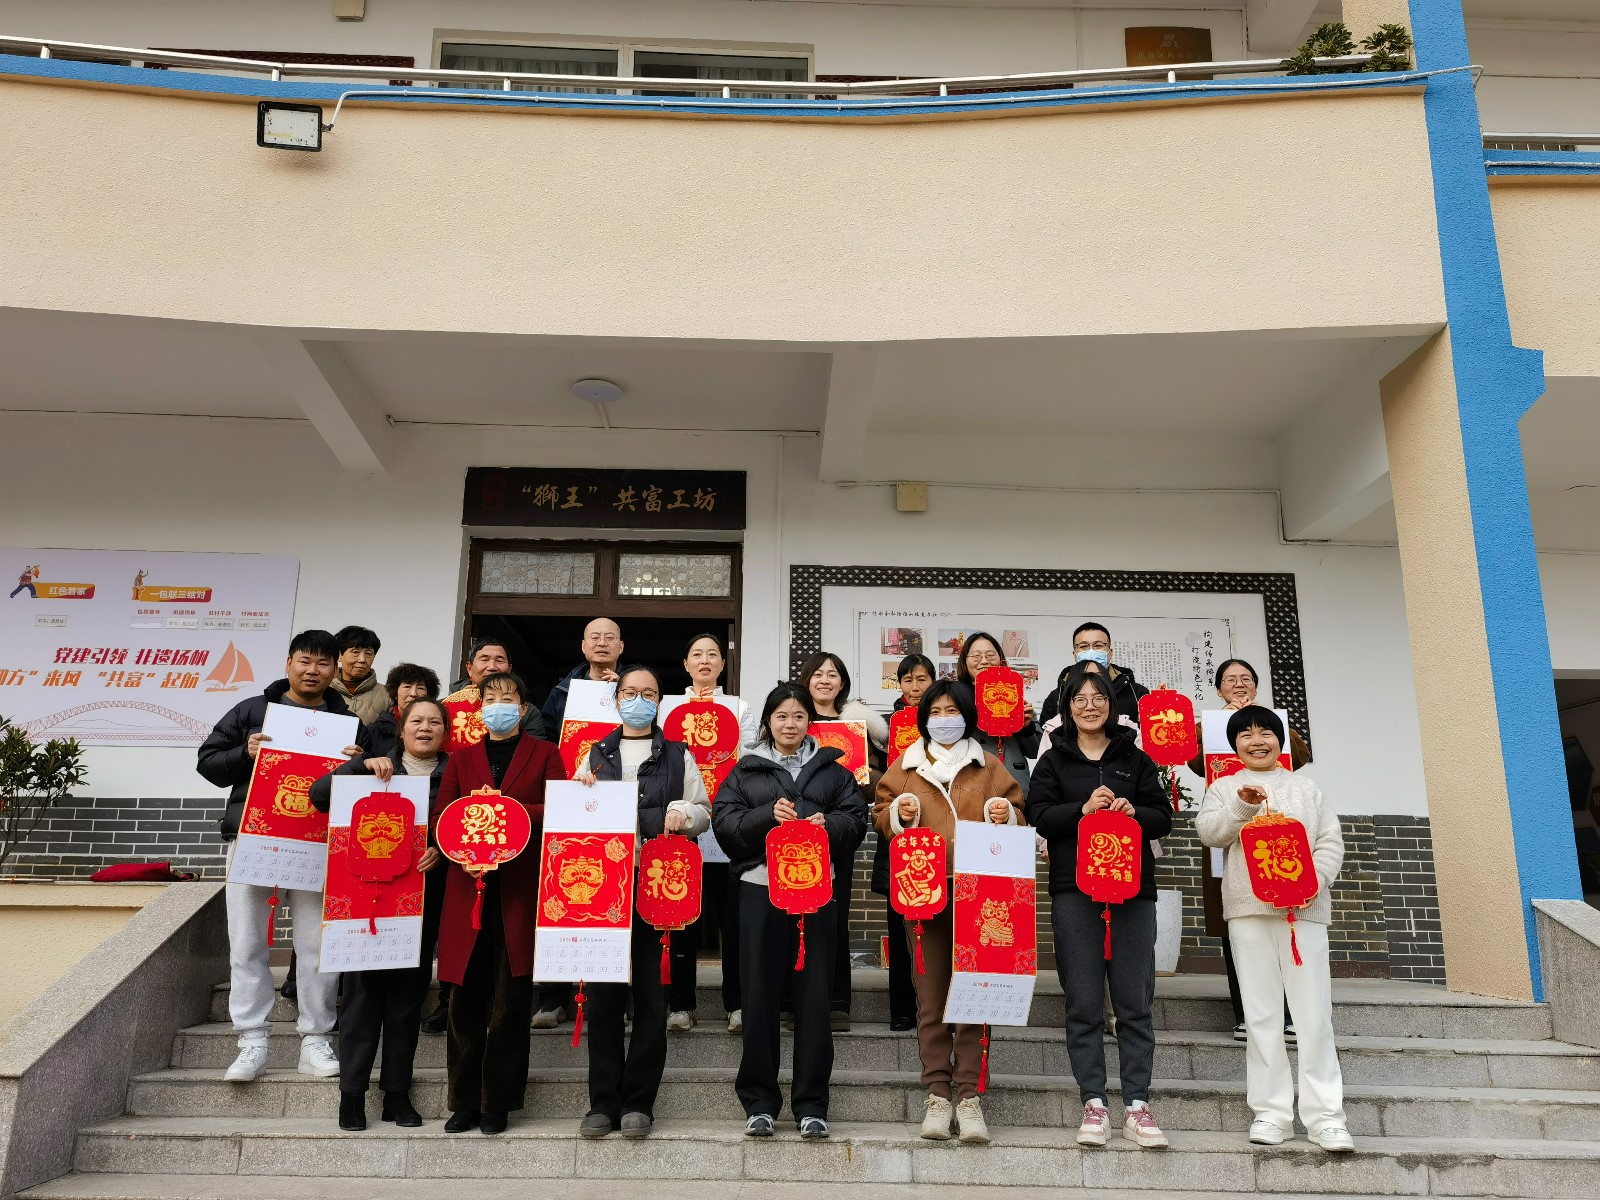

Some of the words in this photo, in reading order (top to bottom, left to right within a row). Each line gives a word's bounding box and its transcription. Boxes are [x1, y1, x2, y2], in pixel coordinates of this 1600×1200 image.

[612, 485, 718, 512] 共富工坊
[53, 647, 129, 665] 党建引领
[134, 648, 210, 666] 非遗扬帆
[460, 833, 507, 845] 年年有鱼
[897, 834, 941, 848] 蛇年大吉
[787, 865, 812, 882] 福
[1086, 865, 1133, 882] 年年有鱼
